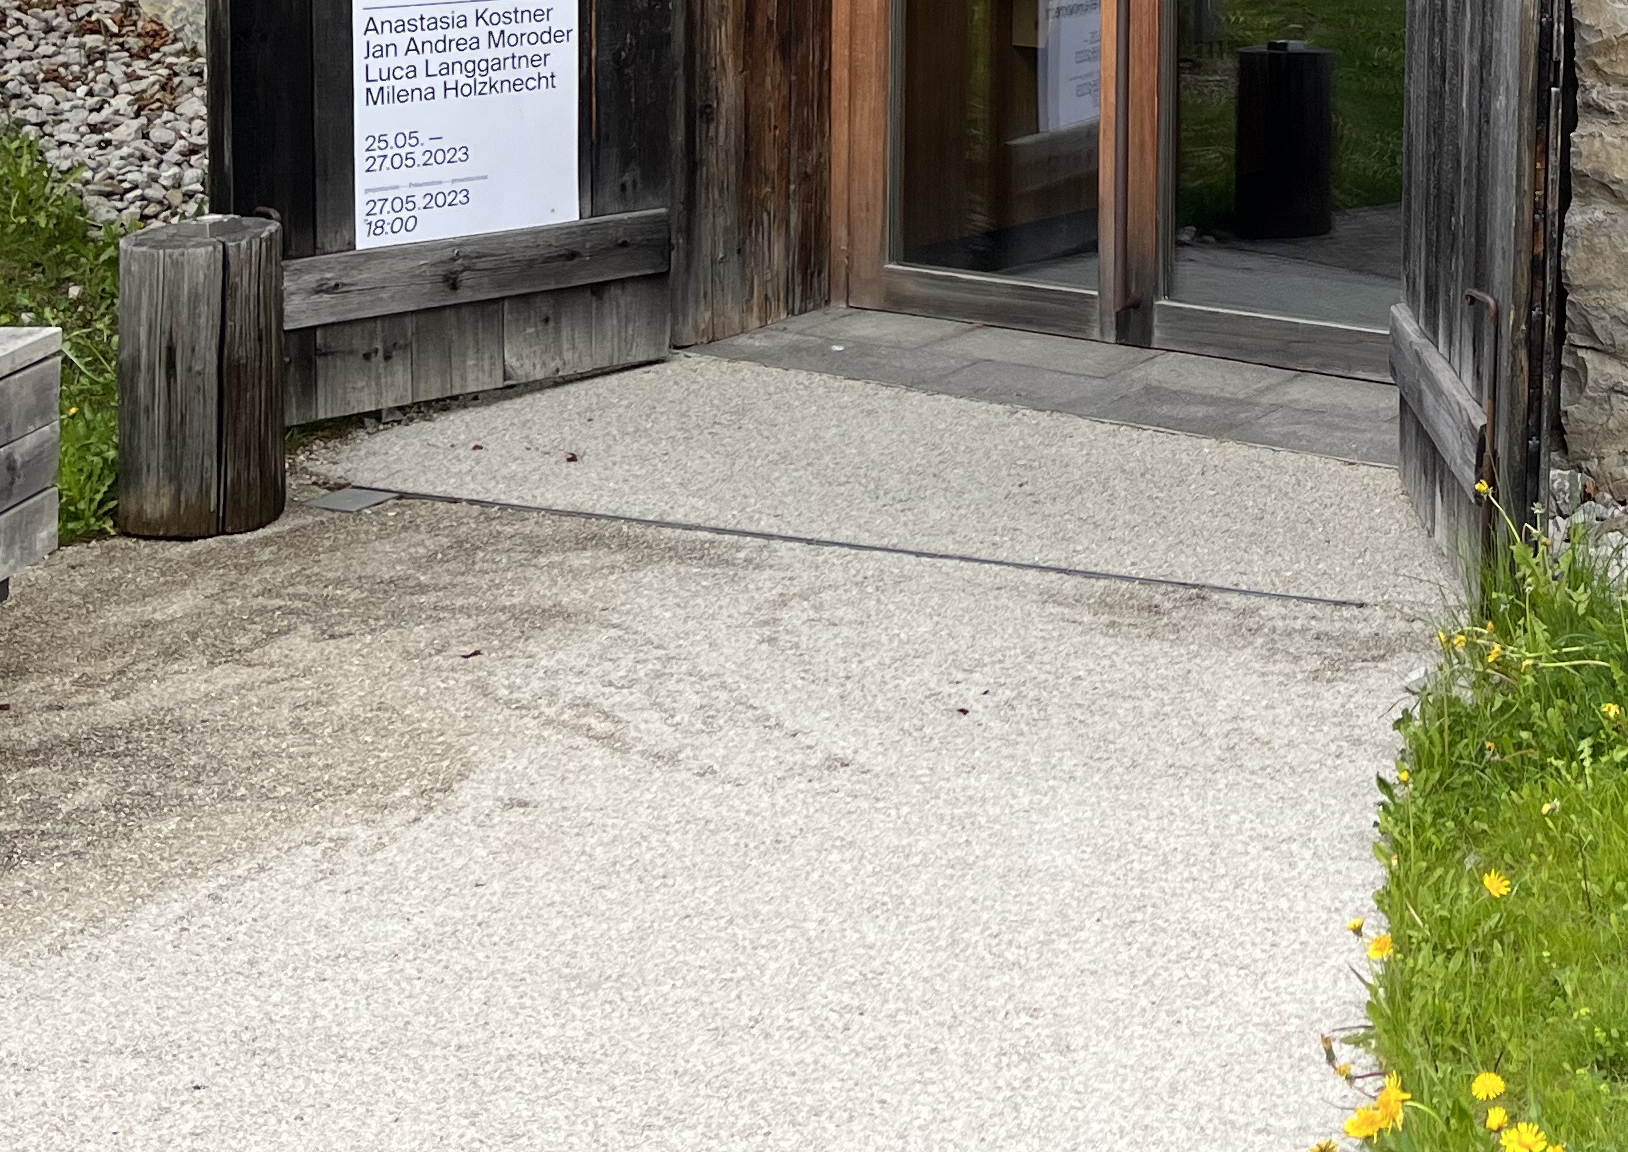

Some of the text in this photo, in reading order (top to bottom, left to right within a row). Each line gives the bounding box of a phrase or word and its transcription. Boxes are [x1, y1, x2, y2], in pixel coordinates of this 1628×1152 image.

[363, 6, 554, 36] Anastasia Kostner
[363, 26, 573, 60] Jan Andrea Moroder
[365, 52, 551, 83] Luca Langgartner
[365, 71, 557, 107] Milena Holzknecht
[364, 130, 425, 153] 25.05.
[364, 145, 470, 173] 27.05.2023
[364, 188, 471, 216] 27.05.2023
[366, 214, 418, 237] 18:00
